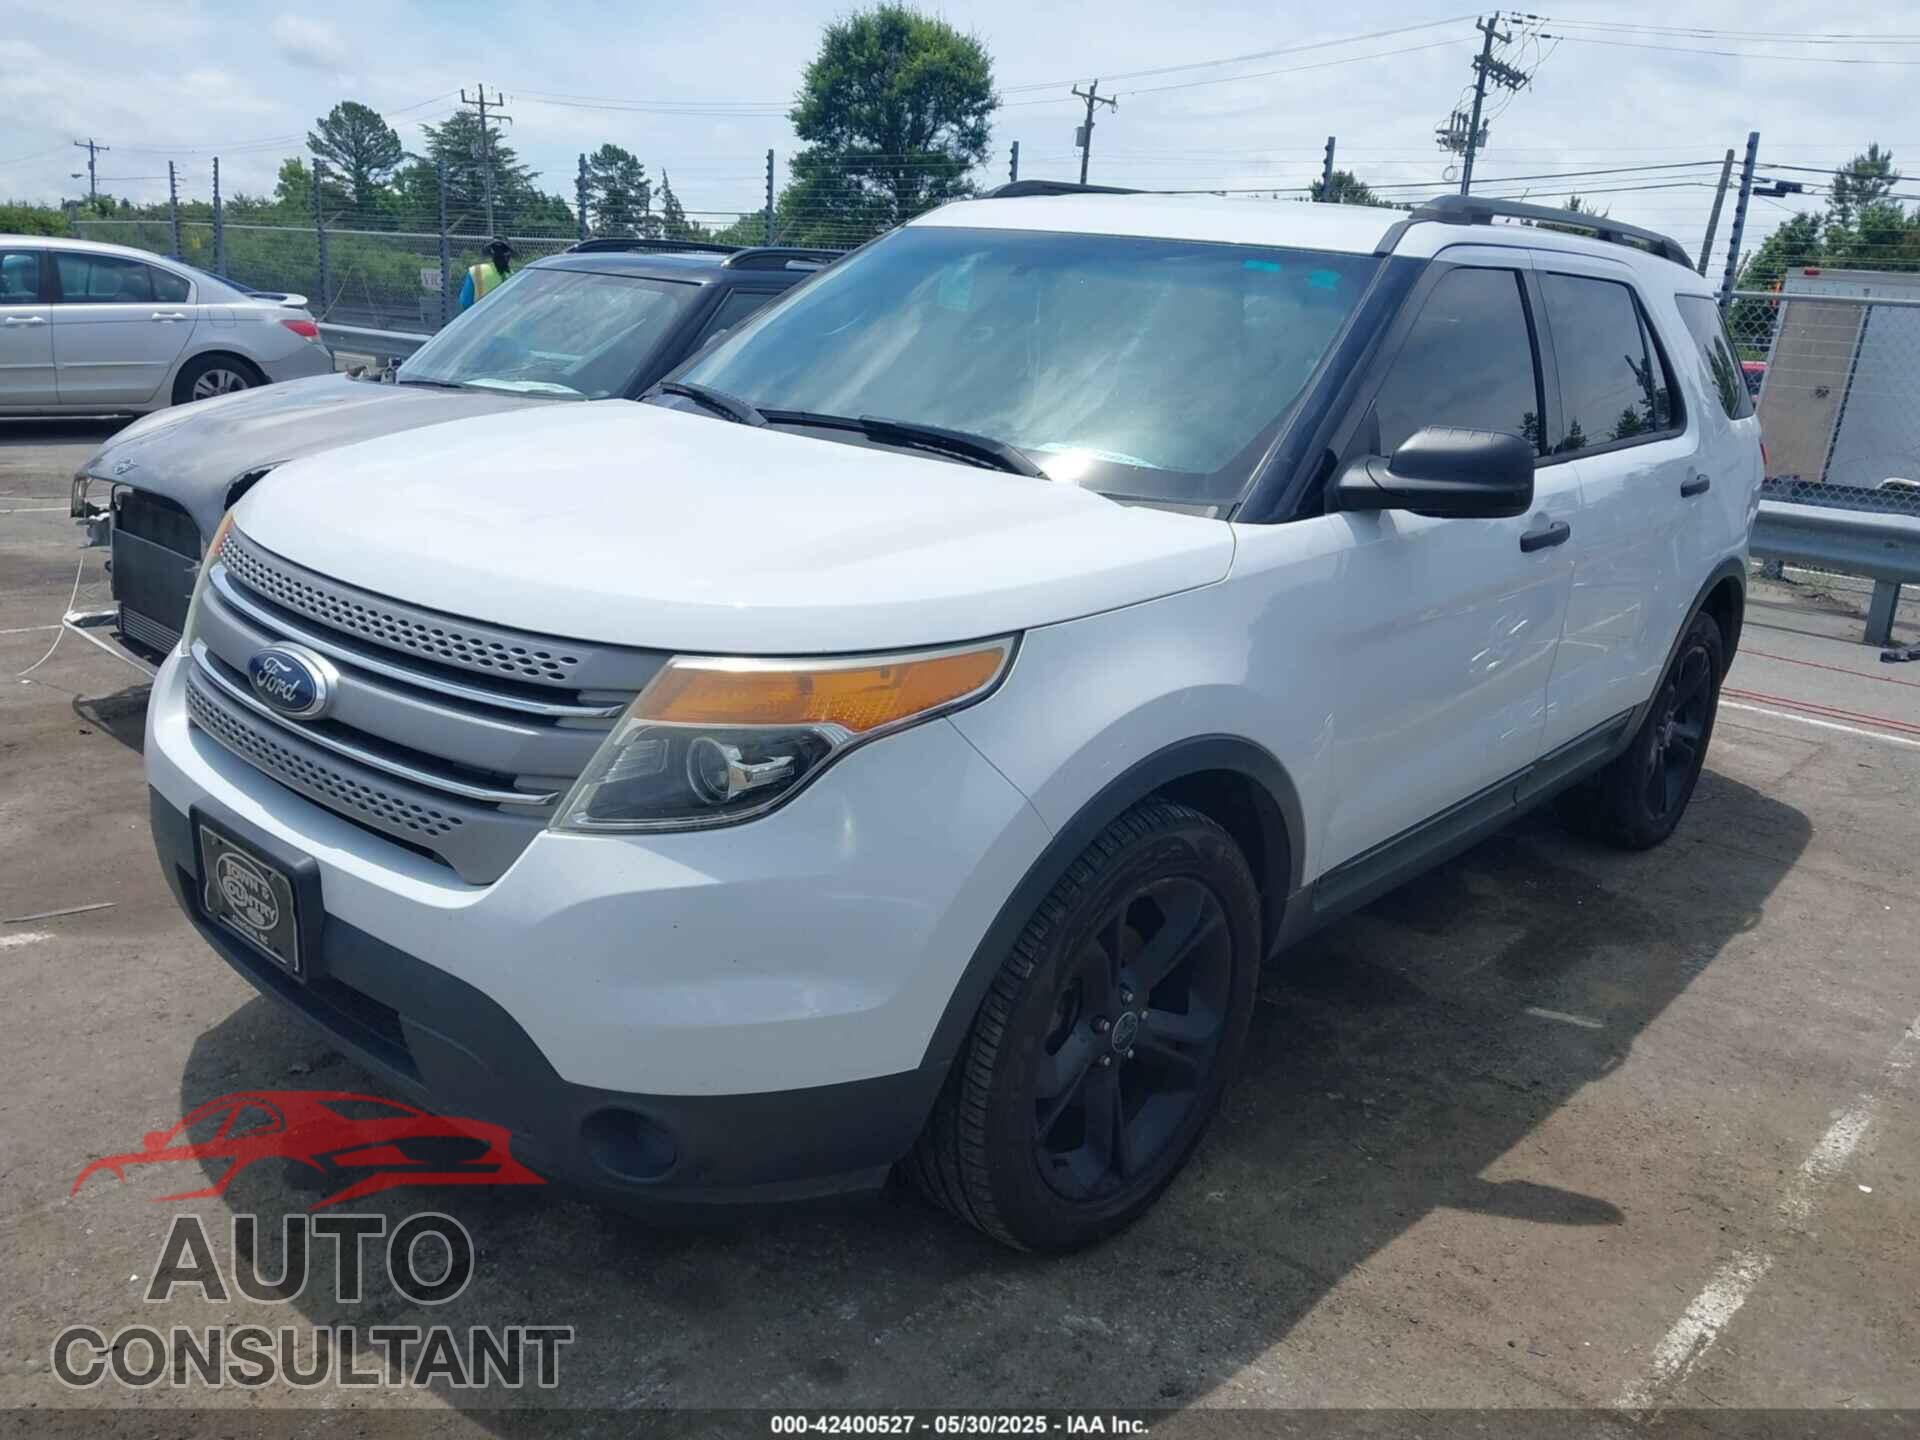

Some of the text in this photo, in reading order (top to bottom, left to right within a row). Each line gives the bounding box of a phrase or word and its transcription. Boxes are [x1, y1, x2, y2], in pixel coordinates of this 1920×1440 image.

[256, 656, 298, 701] Ford
[222, 876, 276, 921] COUNTRY
[225, 860, 259, 892] TOWN
